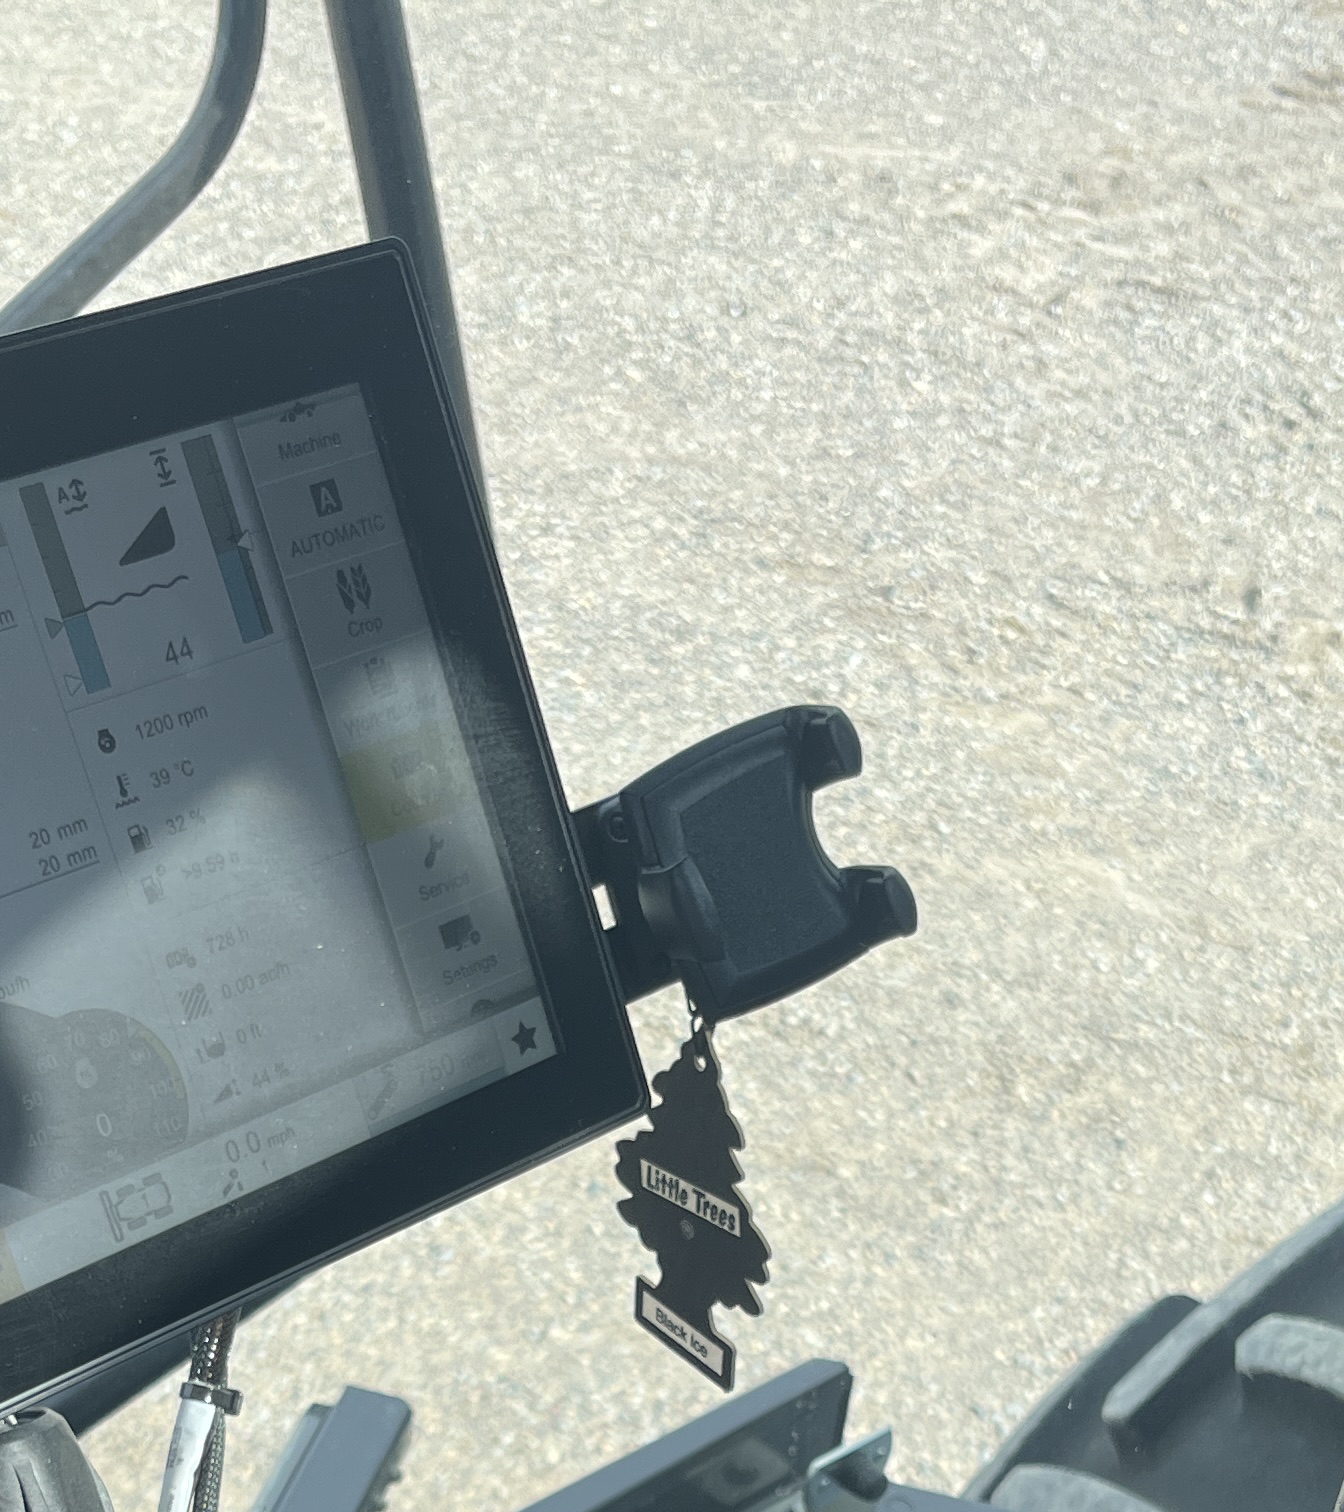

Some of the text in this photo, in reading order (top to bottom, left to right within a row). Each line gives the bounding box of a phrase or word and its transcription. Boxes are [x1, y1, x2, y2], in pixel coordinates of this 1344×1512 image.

[277, 430, 343, 462] Machine
[290, 514, 386, 558] AUTOMATIC
[348, 617, 383, 638] Crop
[165, 636, 194, 666] 44
[135, 704, 209, 740] 1200 rpm
[150, 768, 171, 788] 39
[28, 817, 89, 849] 20 mm
[165, 816, 186, 836] 32
[39, 845, 99, 877] 20 mm
[206, 930, 235, 953] 728
[442, 954, 499, 986] Settings
[221, 973, 256, 999] 0.00
[236, 1029, 248, 1044] 0
[251, 1068, 271, 1088] 44
[96, 1113, 112, 1137] 0
[225, 1126, 296, 1163] 0.0 mph
[646, 1164, 737, 1232] Little Trees
[655, 1307, 709, 1359] Black Ice
